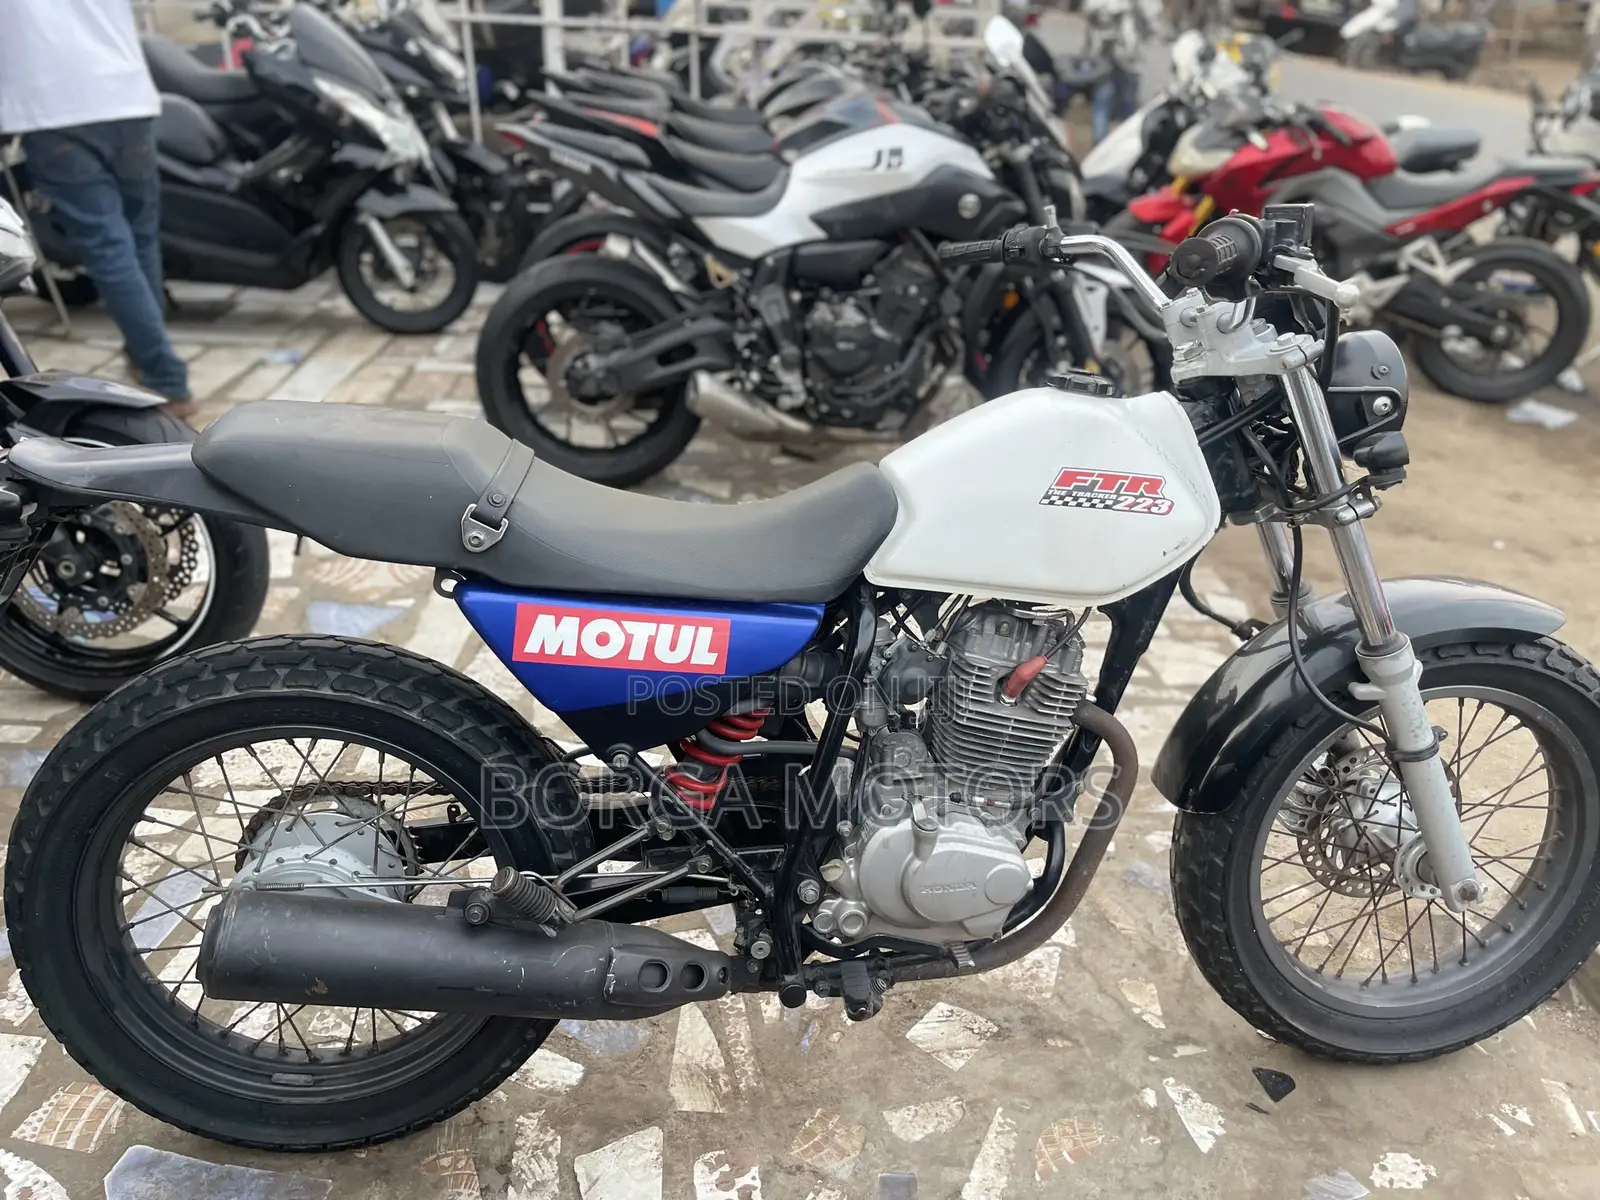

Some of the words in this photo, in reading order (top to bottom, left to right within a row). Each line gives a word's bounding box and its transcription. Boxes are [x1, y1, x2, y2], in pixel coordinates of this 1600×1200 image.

[1052, 469, 1164, 496] FTR
[1047, 488, 1067, 496] THE
[1072, 490, 1117, 499] TRACKER
[1112, 496, 1171, 514] 223
[523, 613, 719, 665] MOTUL
[921, 881, 978, 894] HONDA
